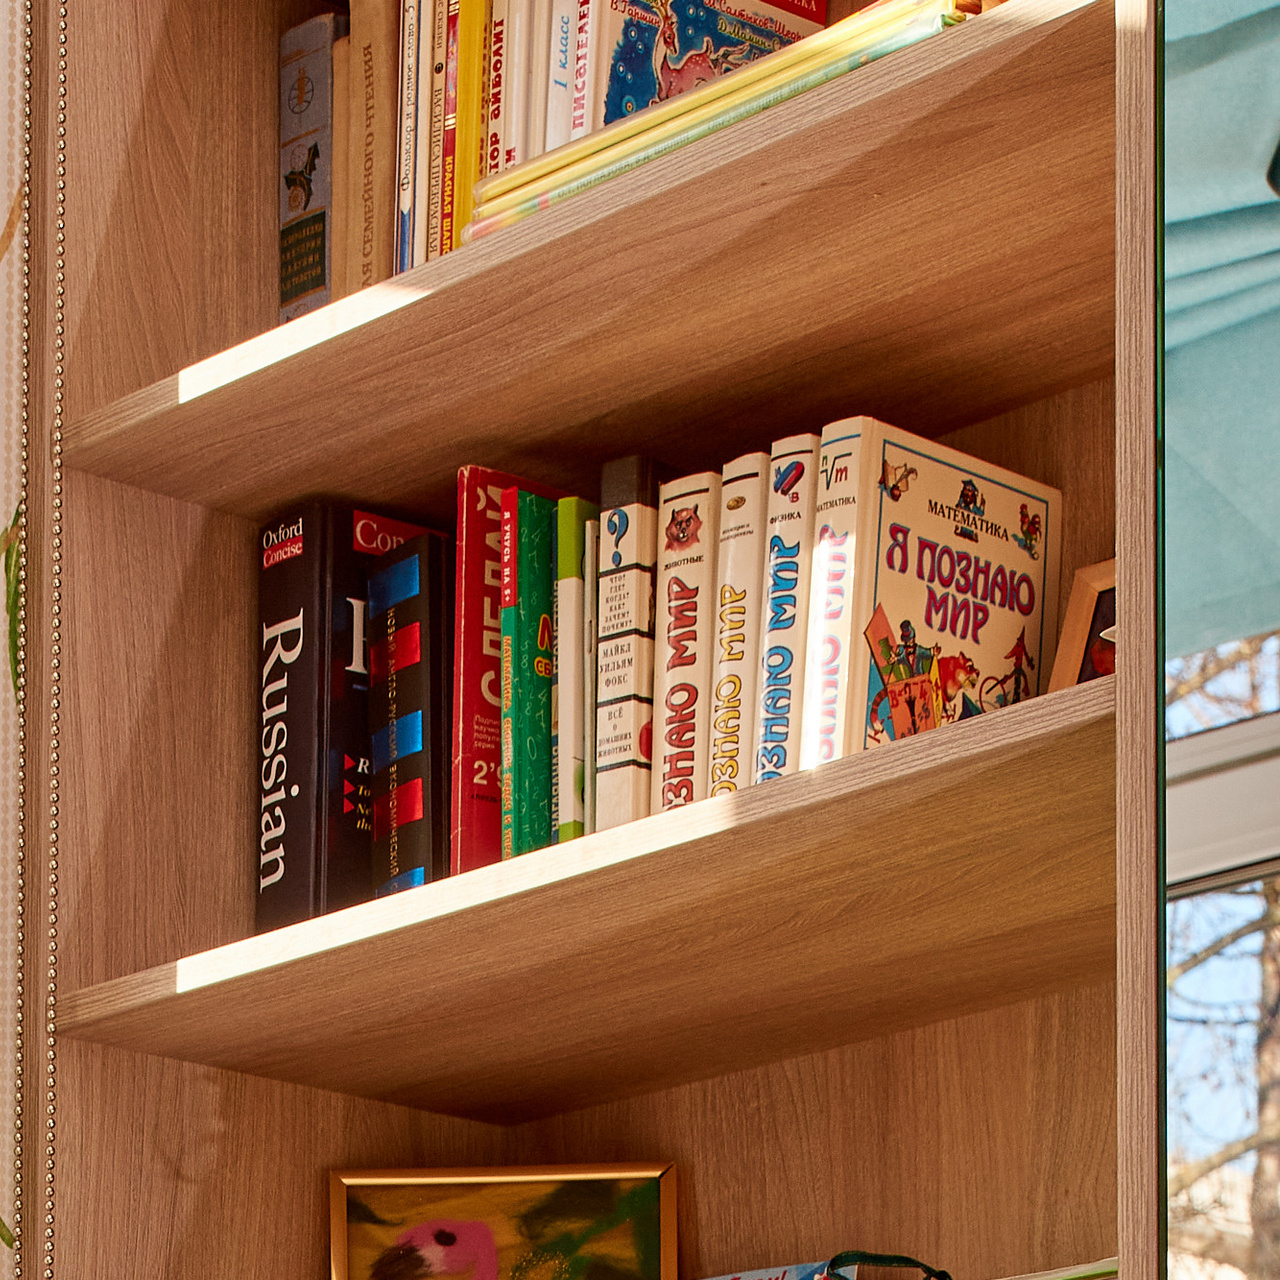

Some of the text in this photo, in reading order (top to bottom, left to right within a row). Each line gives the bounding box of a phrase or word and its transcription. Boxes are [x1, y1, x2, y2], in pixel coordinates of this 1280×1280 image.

[559, 15, 570, 69] класс
[406, 64, 415, 107] родное
[362, 43, 375, 289] ЛЯ СЕМЕЙНОГО ЧТЕНИЯ
[401, 126, 415, 192] Фольклор
[429, 87, 443, 253] ВАСИЛИСА ПРЕКРАСНАЯ
[442, 155, 453, 215] КРАСНАЯ
[263, 517, 303, 550] Oxford
[503, 511, 511, 519] Я
[769, 511, 802, 525] ФИЗИКА
[928, 499, 1010, 542] МАТЕМАТИКА
[263, 541, 303, 569] Concise
[503, 524, 511, 563] УЧУСЬ
[663, 553, 705, 572] ЖИВОТНЫЕ
[503, 568, 511, 583] НА
[770, 534, 801, 633] МИР
[886, 522, 1036, 617] Я ПОЗНАЮ
[386, 608, 396, 652] НОВЫЙ
[666, 575, 700, 673] МИР
[719, 583, 747, 664] МИР
[924, 584, 990, 646] МИР
[599, 657, 634, 674] УИЛЬЯМ
[603, 643, 631, 659] МАЙКЛ
[604, 673, 629, 688] ФОКС
[607, 707, 624, 721] ВСЁ
[260, 607, 304, 894] Russian
[502, 773, 512, 811] ЗАДАЧ
[389, 764, 400, 877] ЭКОНОМИЧЕСКИЙ
